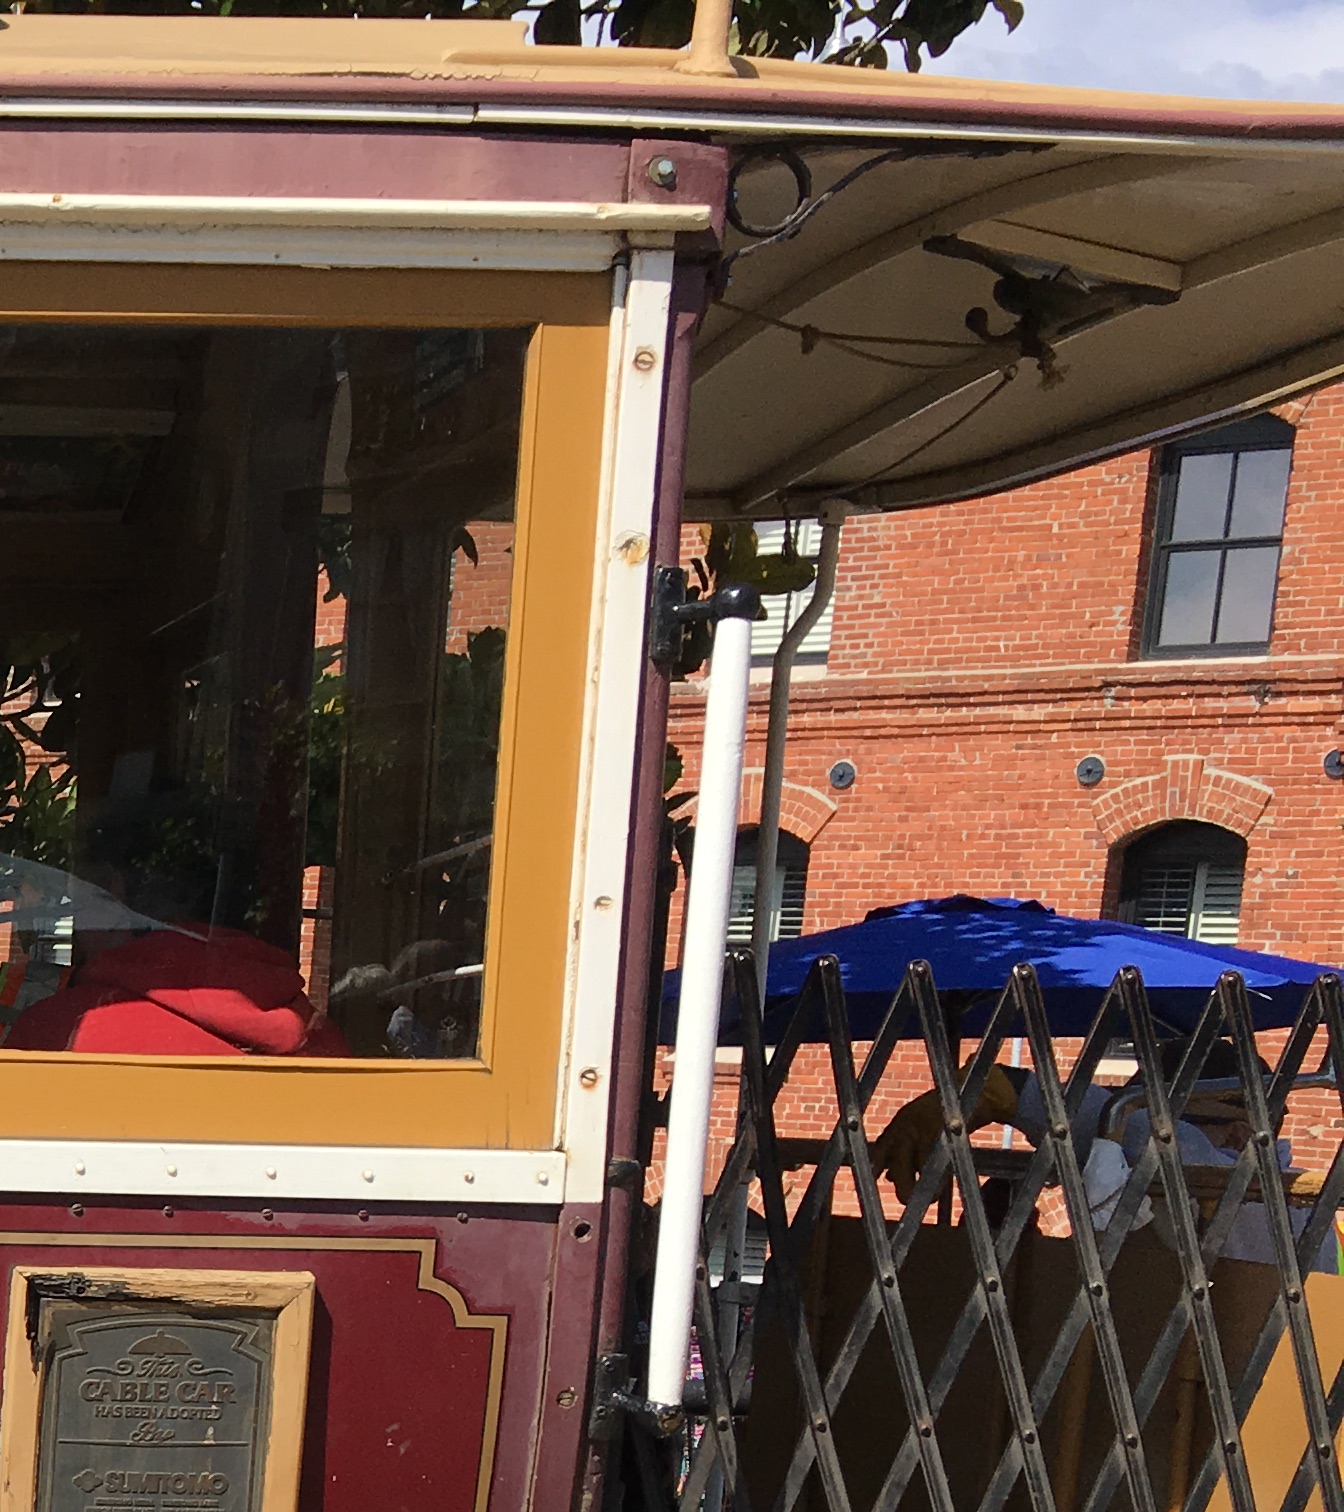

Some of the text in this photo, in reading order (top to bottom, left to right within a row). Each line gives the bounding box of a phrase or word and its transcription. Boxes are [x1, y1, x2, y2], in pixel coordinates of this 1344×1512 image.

[78, 1378, 237, 1404] CABLE CAR
[94, 1405, 222, 1421] HAS BEEN ADOPTED
